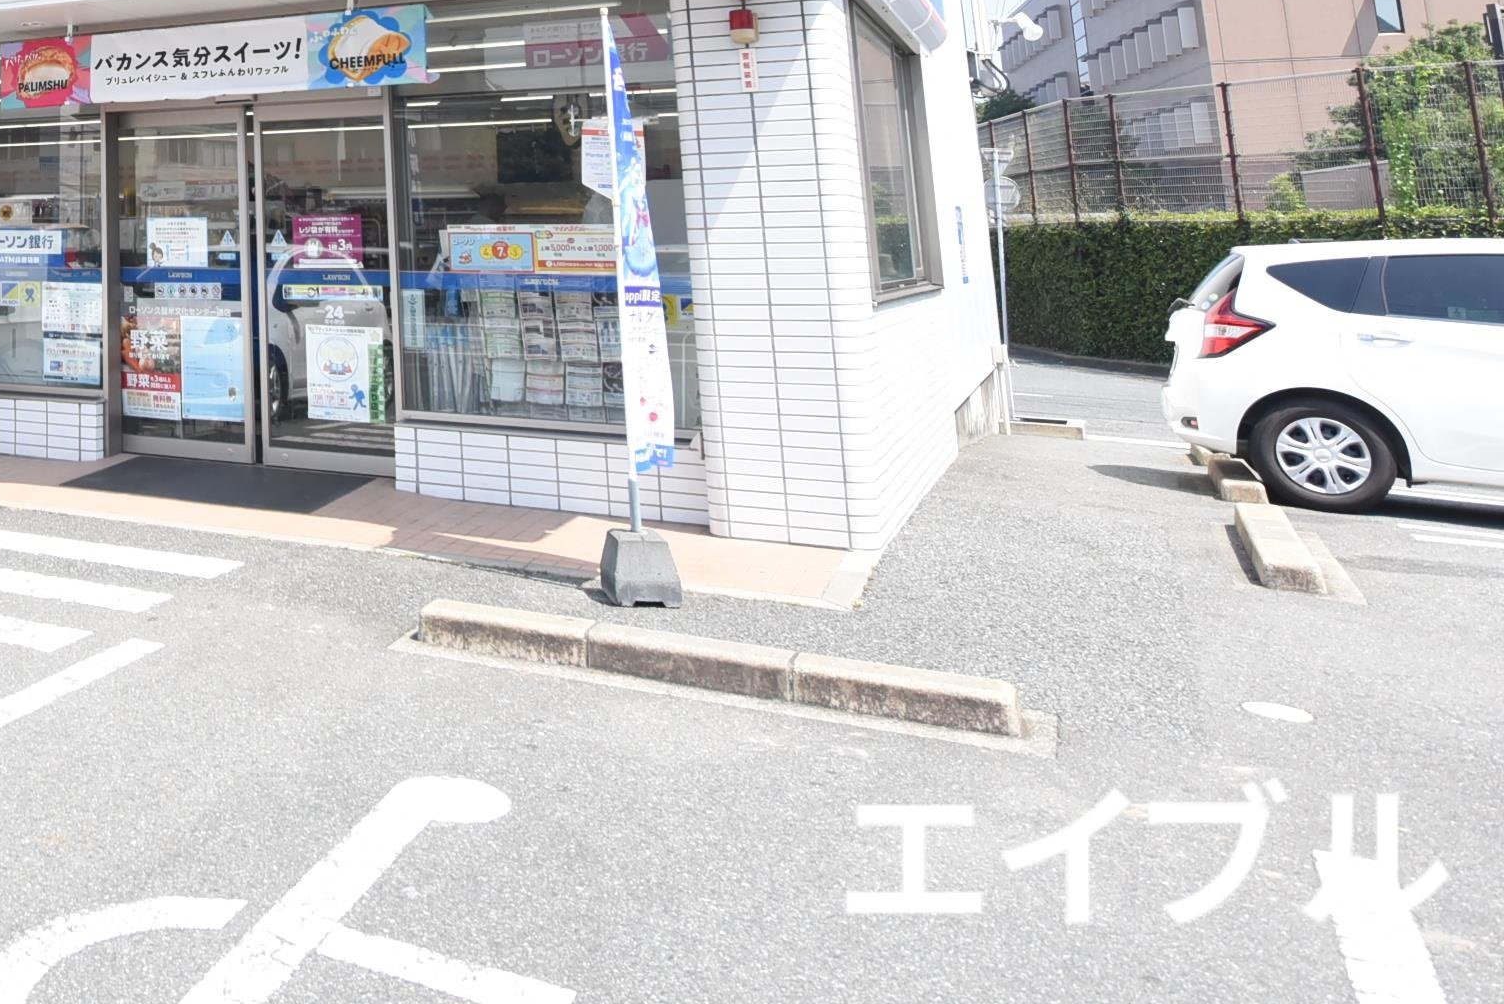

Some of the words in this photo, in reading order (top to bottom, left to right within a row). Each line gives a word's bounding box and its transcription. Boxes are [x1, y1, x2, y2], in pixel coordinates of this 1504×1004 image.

[94, 37, 302, 72] バカンス気分スイーツ!
[329, 52, 406, 70] CHEEMFULL
[18, 78, 69, 94] PALIMSHU
[324, 305, 344, 319] 24
[130, 329, 168, 351] 野菜
[126, 373, 150, 388] 野菜
